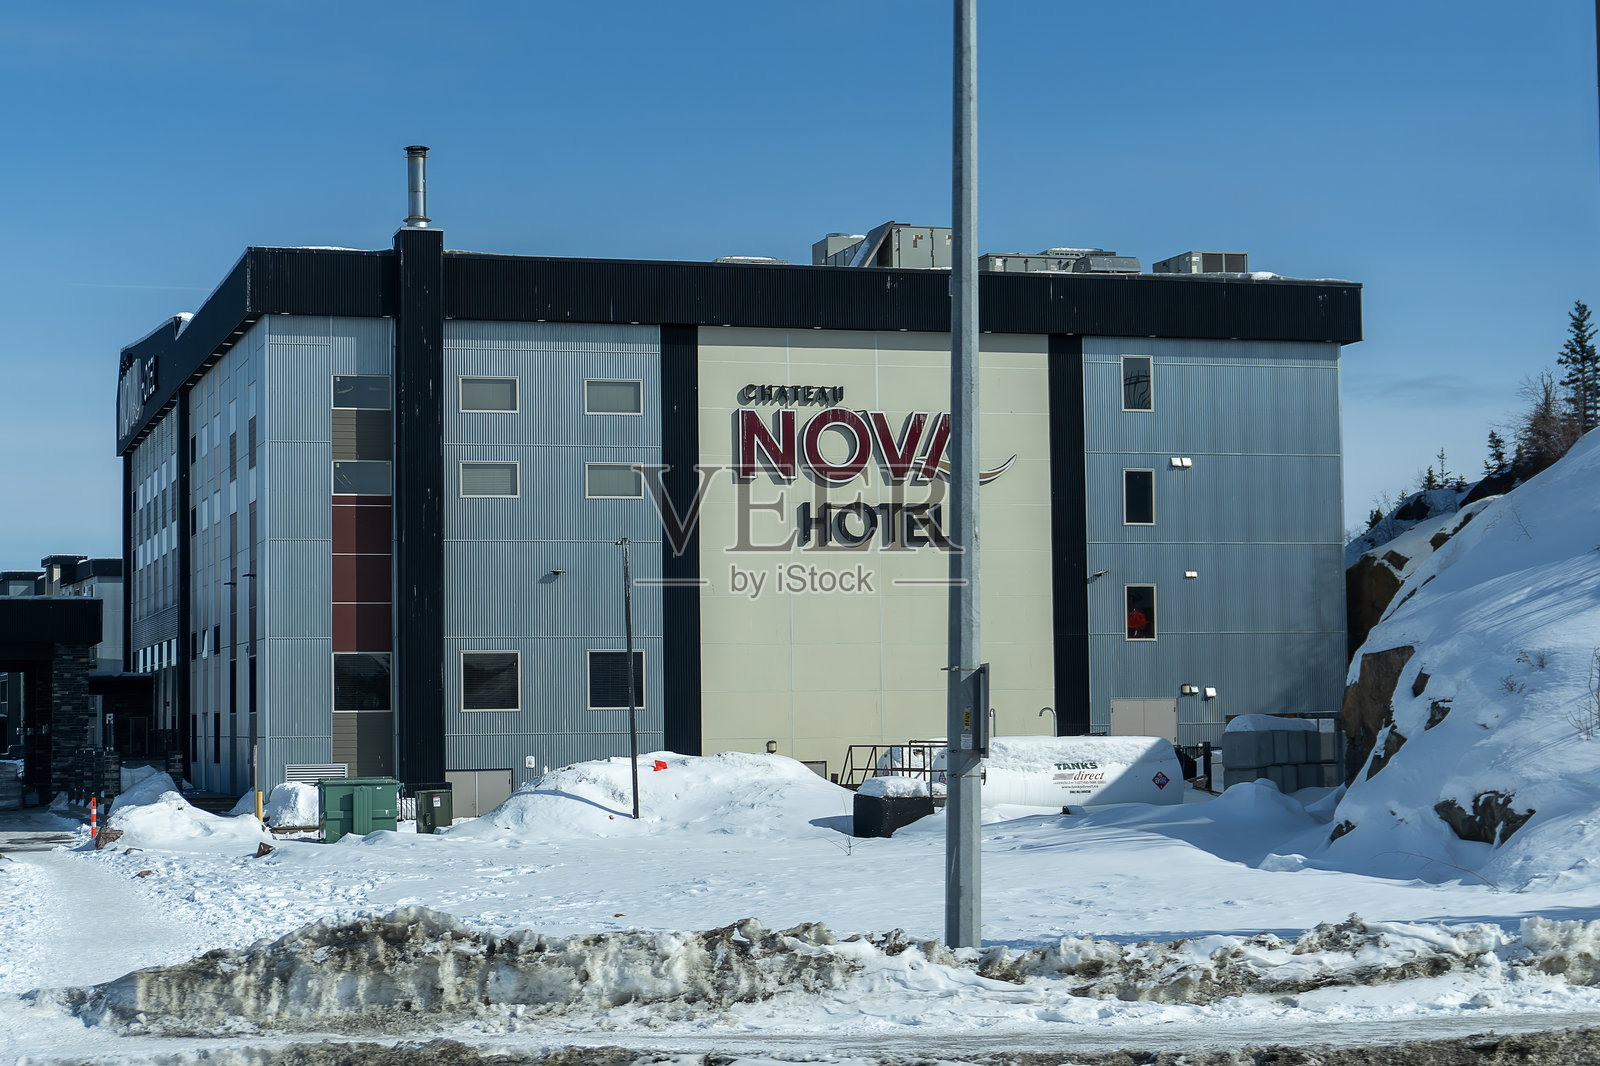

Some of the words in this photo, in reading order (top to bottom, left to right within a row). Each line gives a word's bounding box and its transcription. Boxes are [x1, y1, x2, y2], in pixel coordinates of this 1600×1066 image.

[740, 384, 843, 405] CHATEAU
[798, 502, 950, 546] HOTEL
[1054, 762, 1098, 770] TANKS
[1073, 771, 1105, 780] direct
